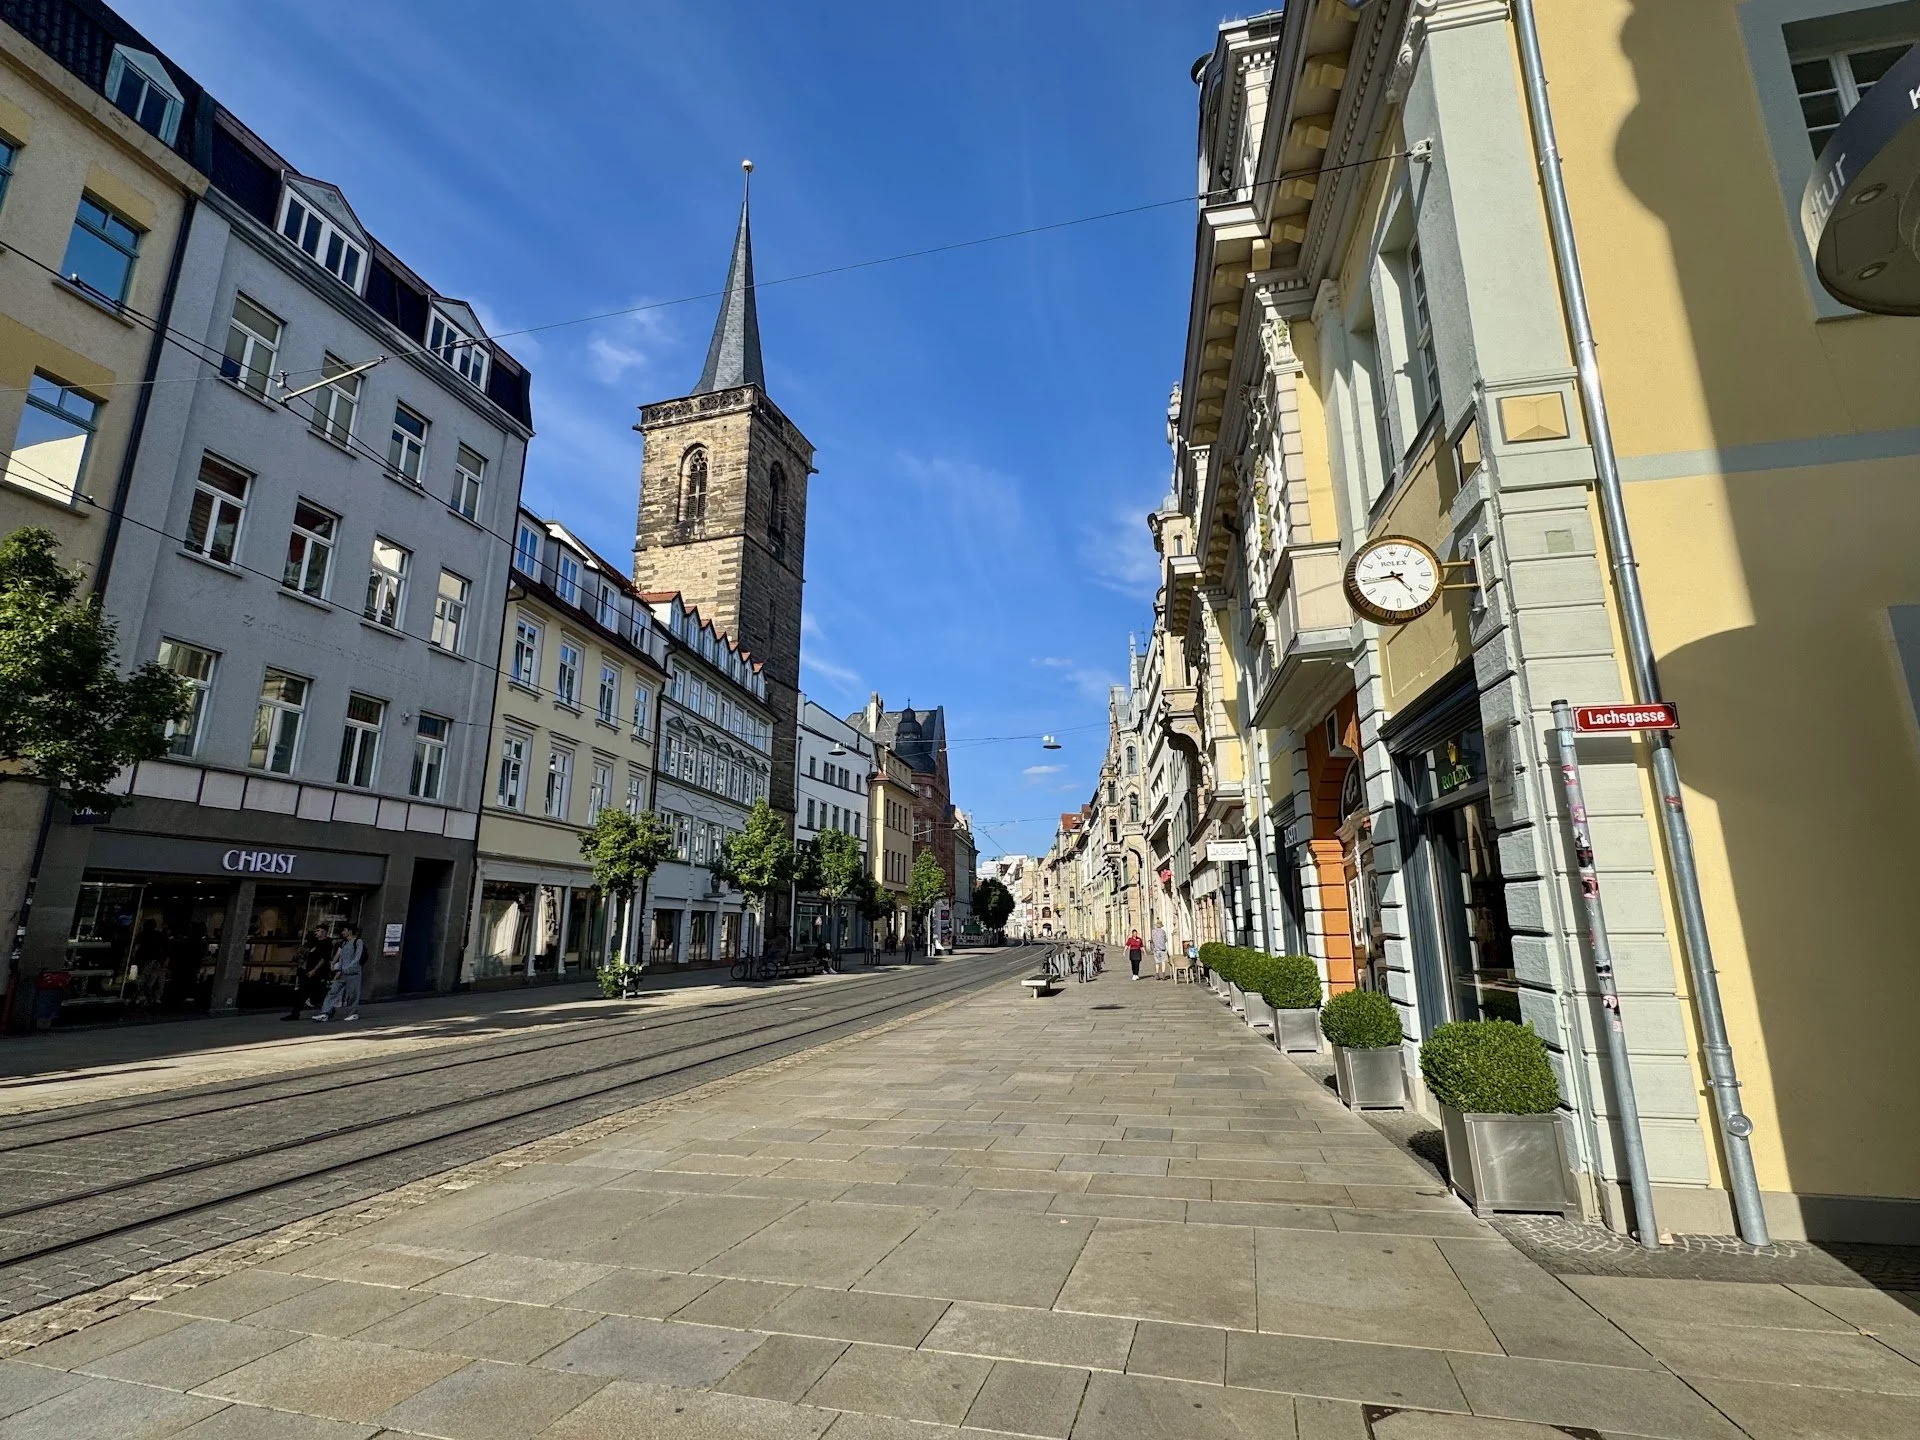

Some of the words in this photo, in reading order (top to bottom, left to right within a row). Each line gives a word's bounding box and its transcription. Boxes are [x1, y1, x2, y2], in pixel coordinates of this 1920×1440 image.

[1804, 153, 1846, 246] ultur
[1587, 710, 1666, 727] Lachsgasse
[1441, 765, 1472, 790] ROLEX
[222, 850, 297, 873] CHRIST
